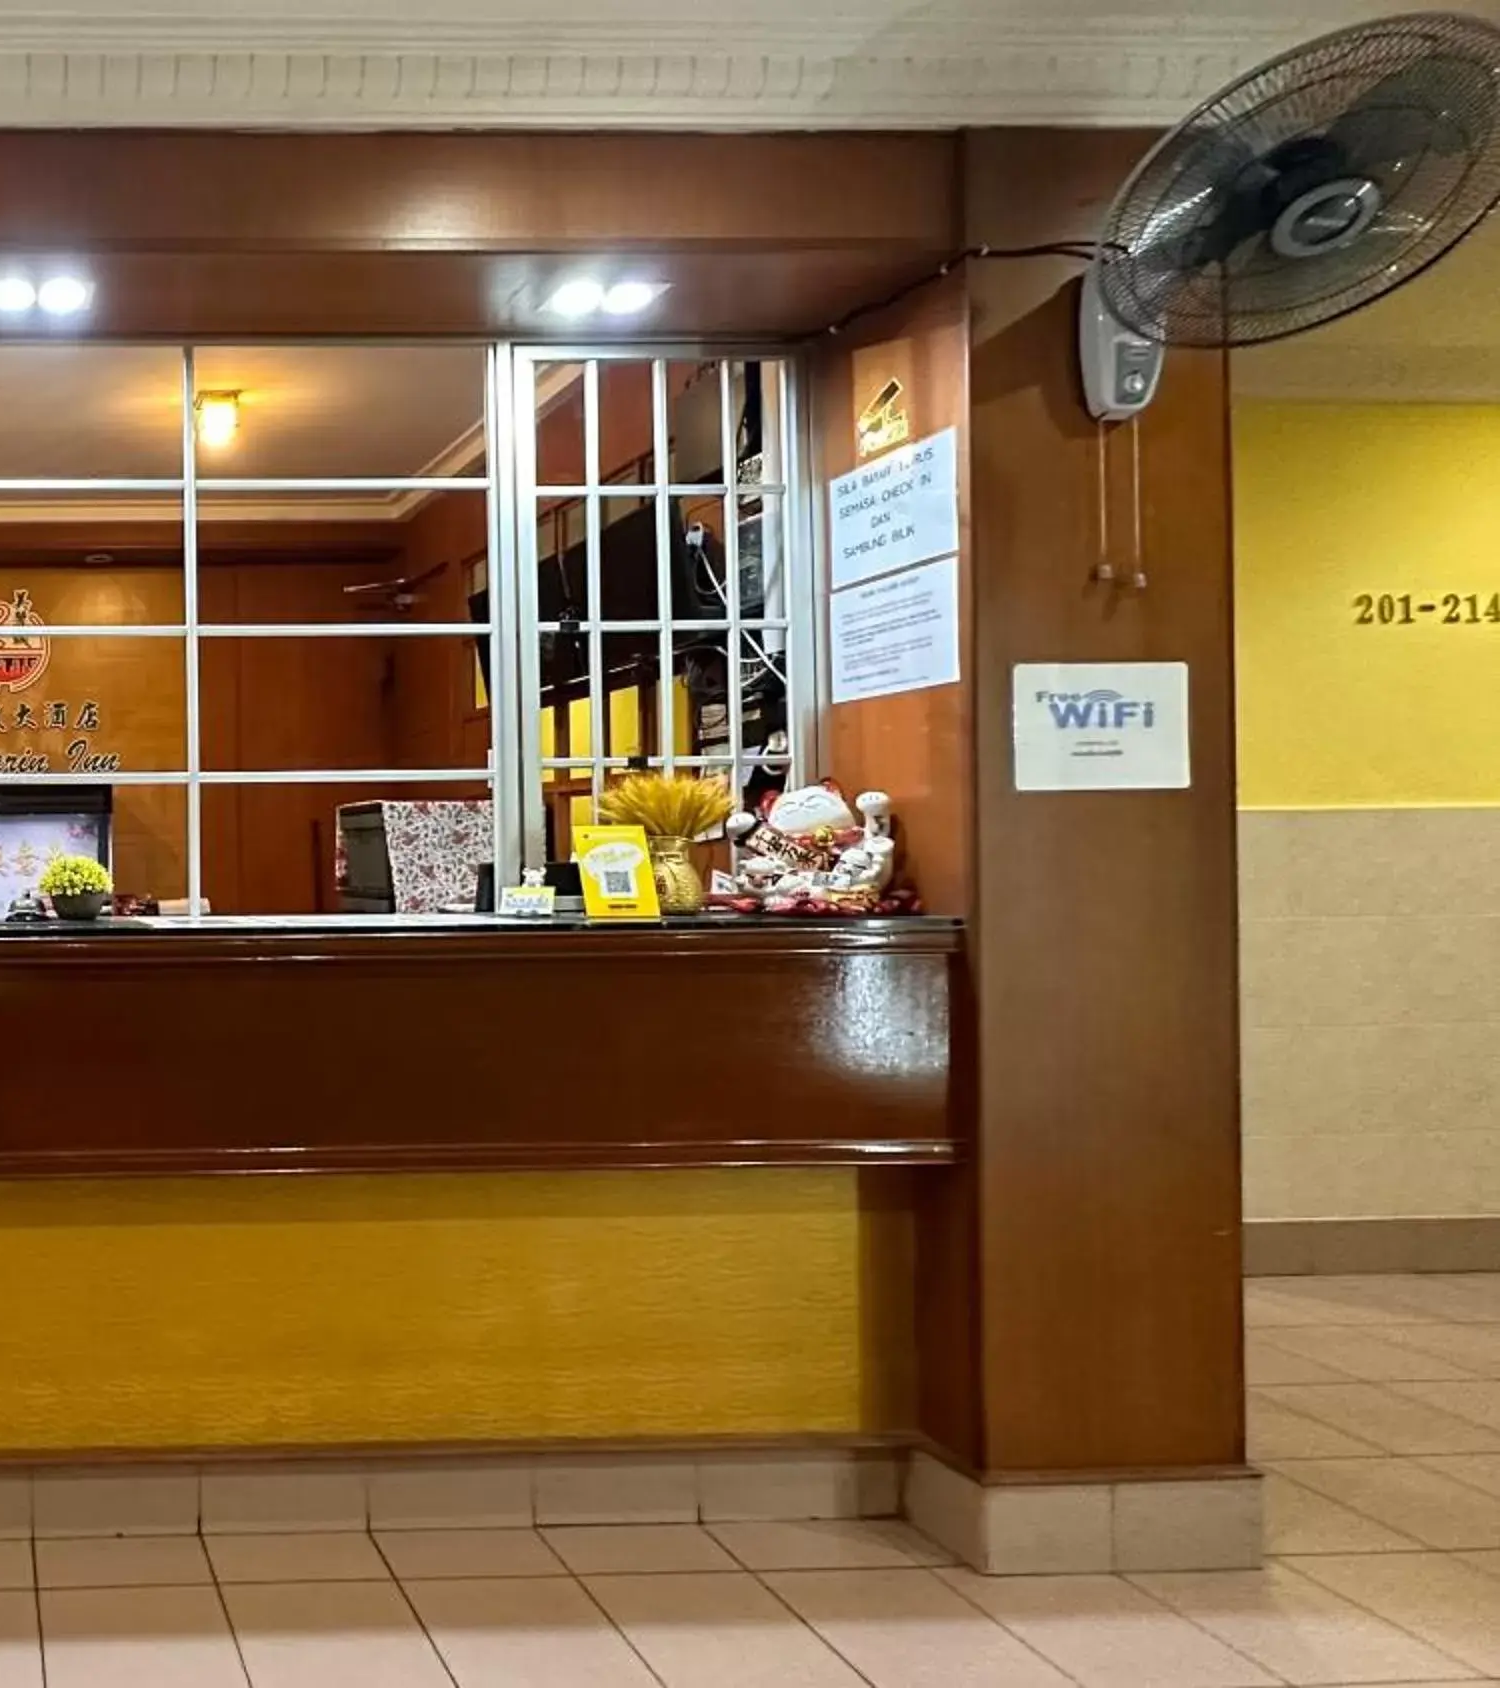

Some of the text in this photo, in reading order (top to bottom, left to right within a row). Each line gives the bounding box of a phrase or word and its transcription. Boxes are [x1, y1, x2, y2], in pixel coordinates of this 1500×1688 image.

[1352, 592, 1500, 625] 201-214
[1035, 690, 1082, 703] Free
[1049, 701, 1155, 729] WiFi
[67, 739, 120, 772] Inn
